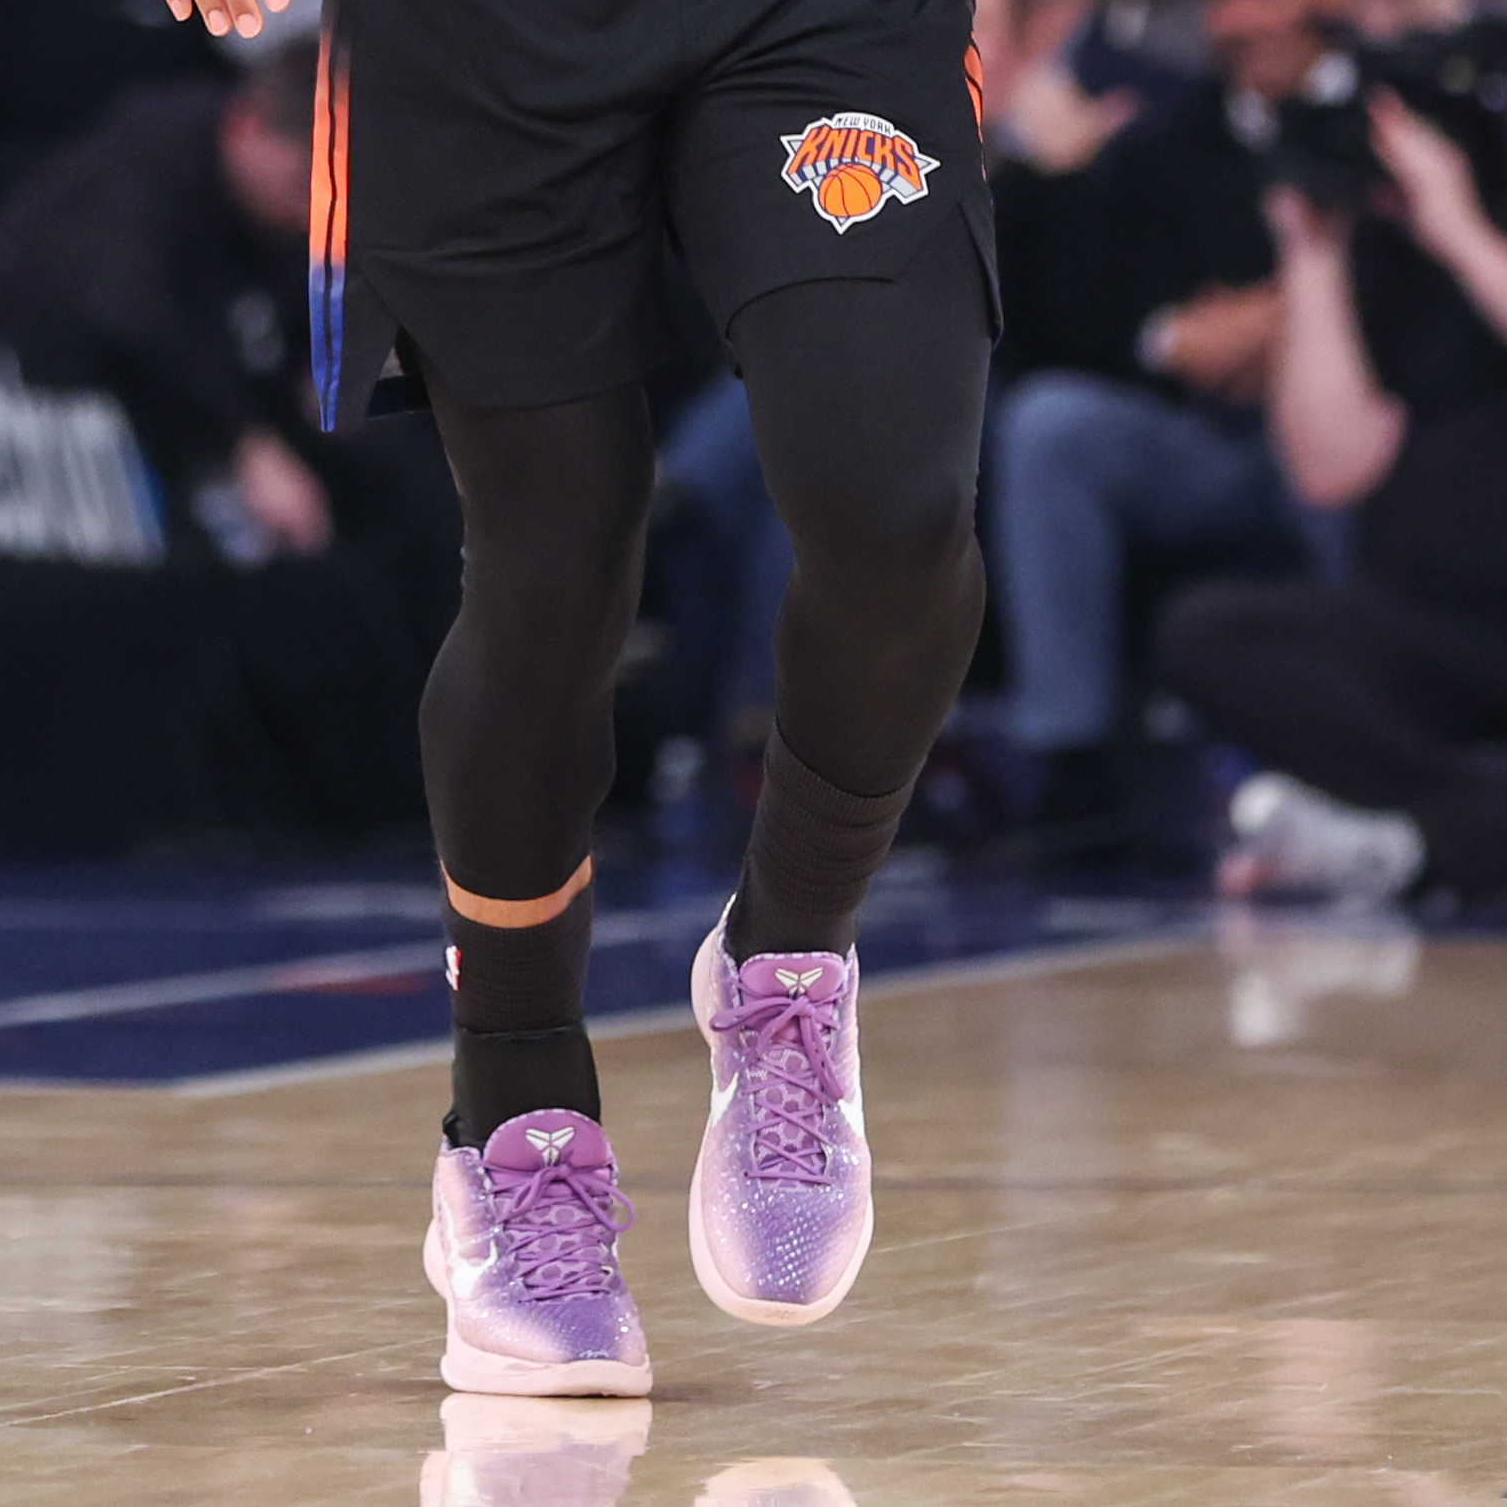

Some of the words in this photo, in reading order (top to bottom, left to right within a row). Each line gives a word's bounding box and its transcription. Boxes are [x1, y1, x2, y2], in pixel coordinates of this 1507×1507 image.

[834, 116, 860, 127] NEW
[863, 118, 891, 135] YORK
[787, 125, 924, 191] KNICKS
